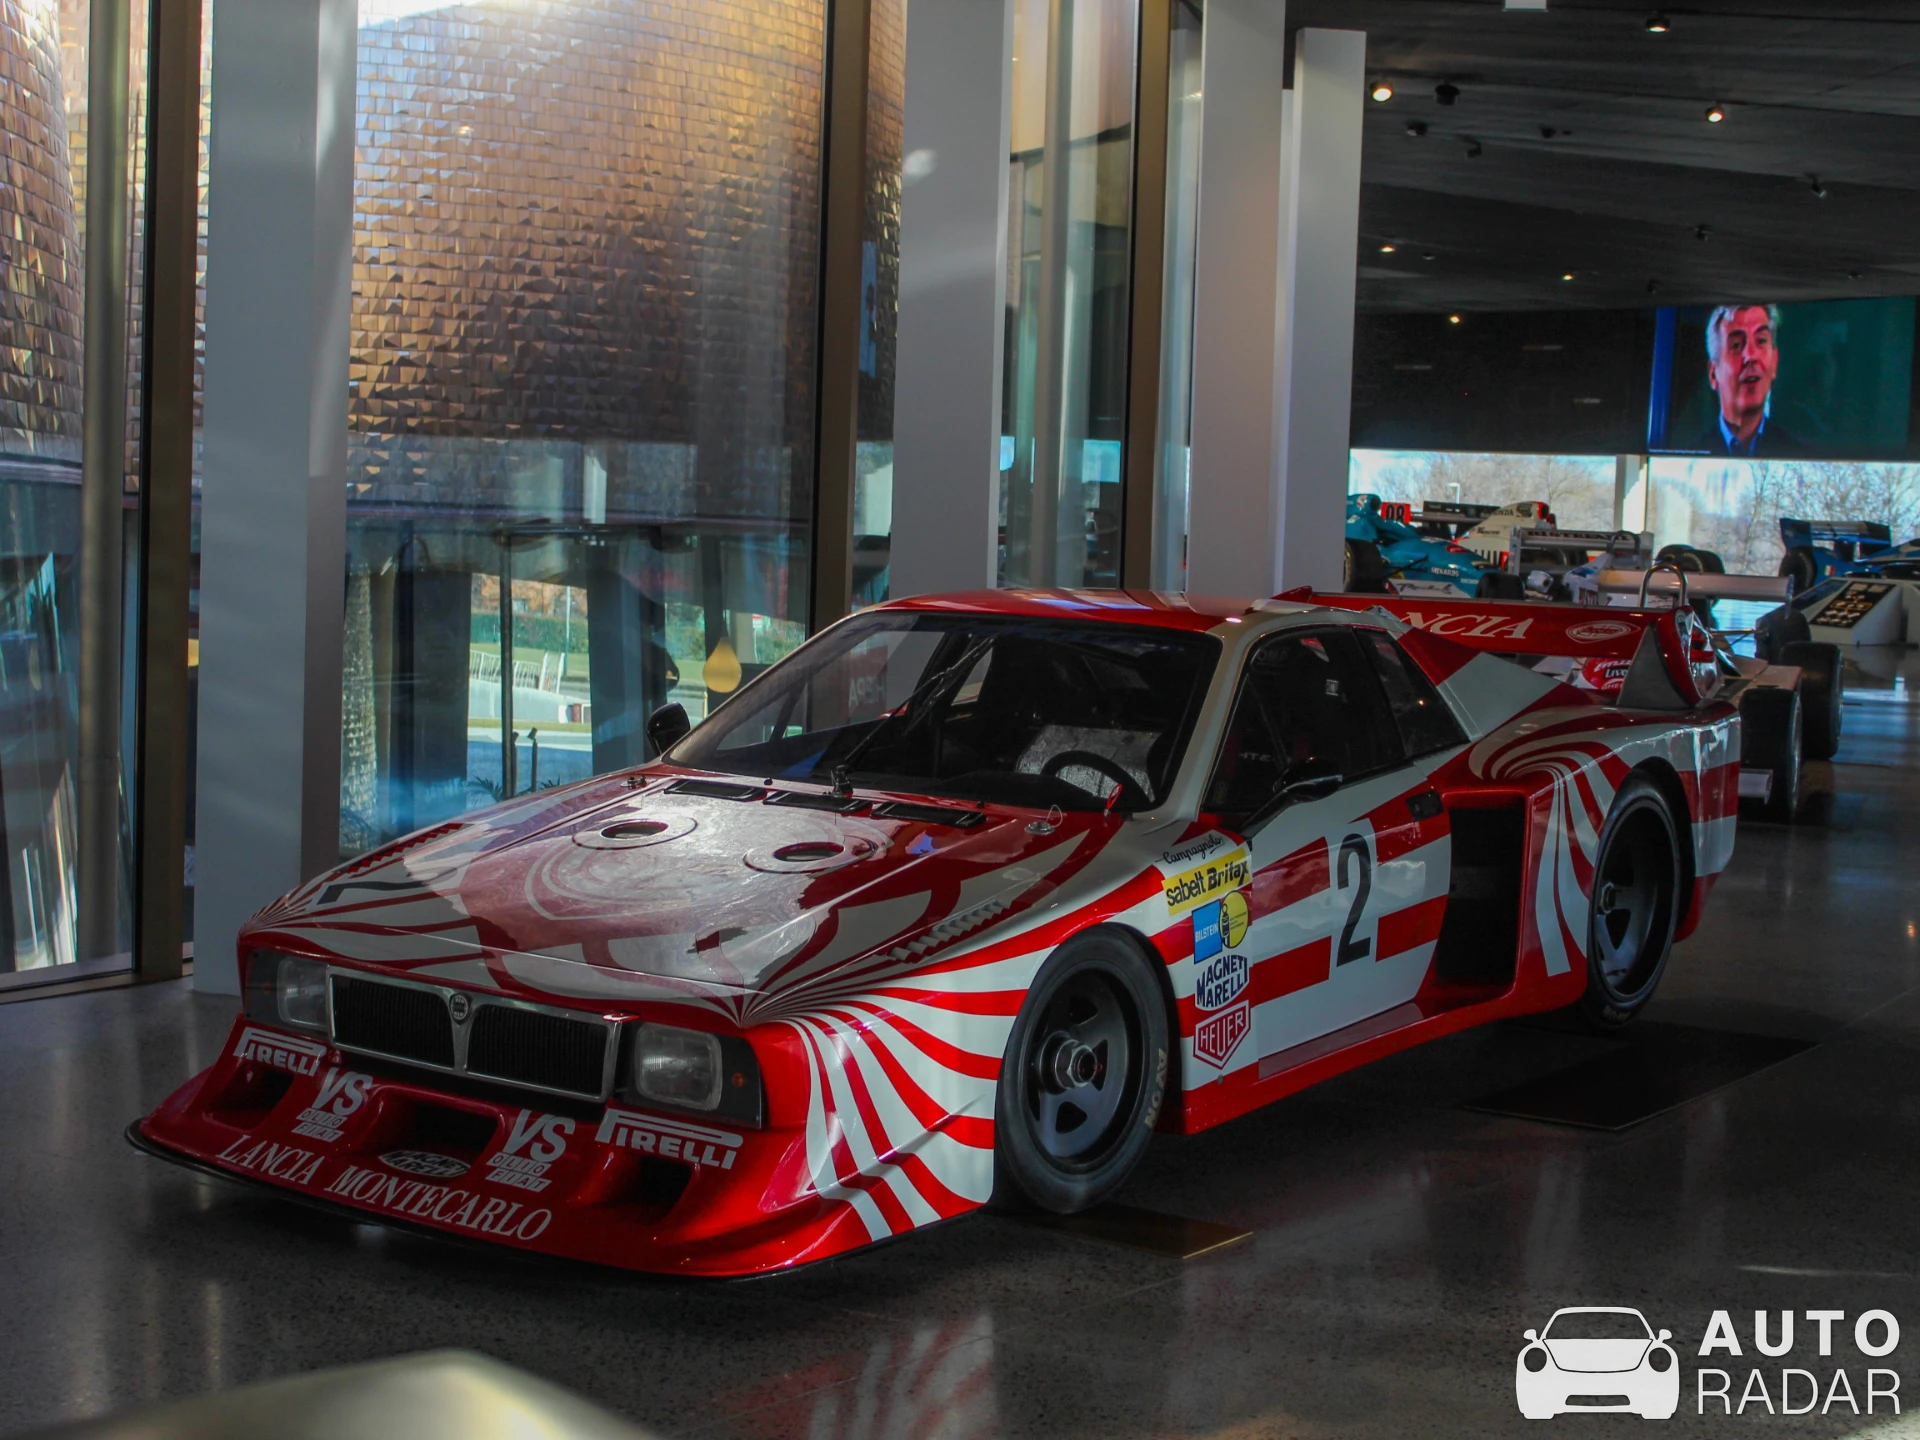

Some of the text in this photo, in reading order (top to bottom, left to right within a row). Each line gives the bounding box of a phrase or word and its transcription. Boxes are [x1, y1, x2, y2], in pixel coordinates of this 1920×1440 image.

[1155, 833, 1225, 864] Campagnolo
[1166, 858, 1249, 907] sabelt Britax
[1336, 833, 1371, 967] 2
[1194, 922, 1219, 943] BILSTEIN
[1196, 954, 1248, 994] MAGNETI
[1196, 972, 1248, 1008] MARELLI
[233, 1026, 328, 1077] PIRELLI
[1200, 1010, 1244, 1057] HEUER
[311, 1066, 373, 1116] VS
[1143, 1047, 1169, 1129] AVON
[293, 1122, 343, 1141] FIAT
[297, 1108, 346, 1128] OLIO
[503, 1108, 576, 1163] VS
[594, 1108, 744, 1171] PIRELLI
[217, 1133, 553, 1241] LANCIA MONTECARLO
[487, 1169, 550, 1191] FIAT
[488, 1153, 550, 1176] OLIO
